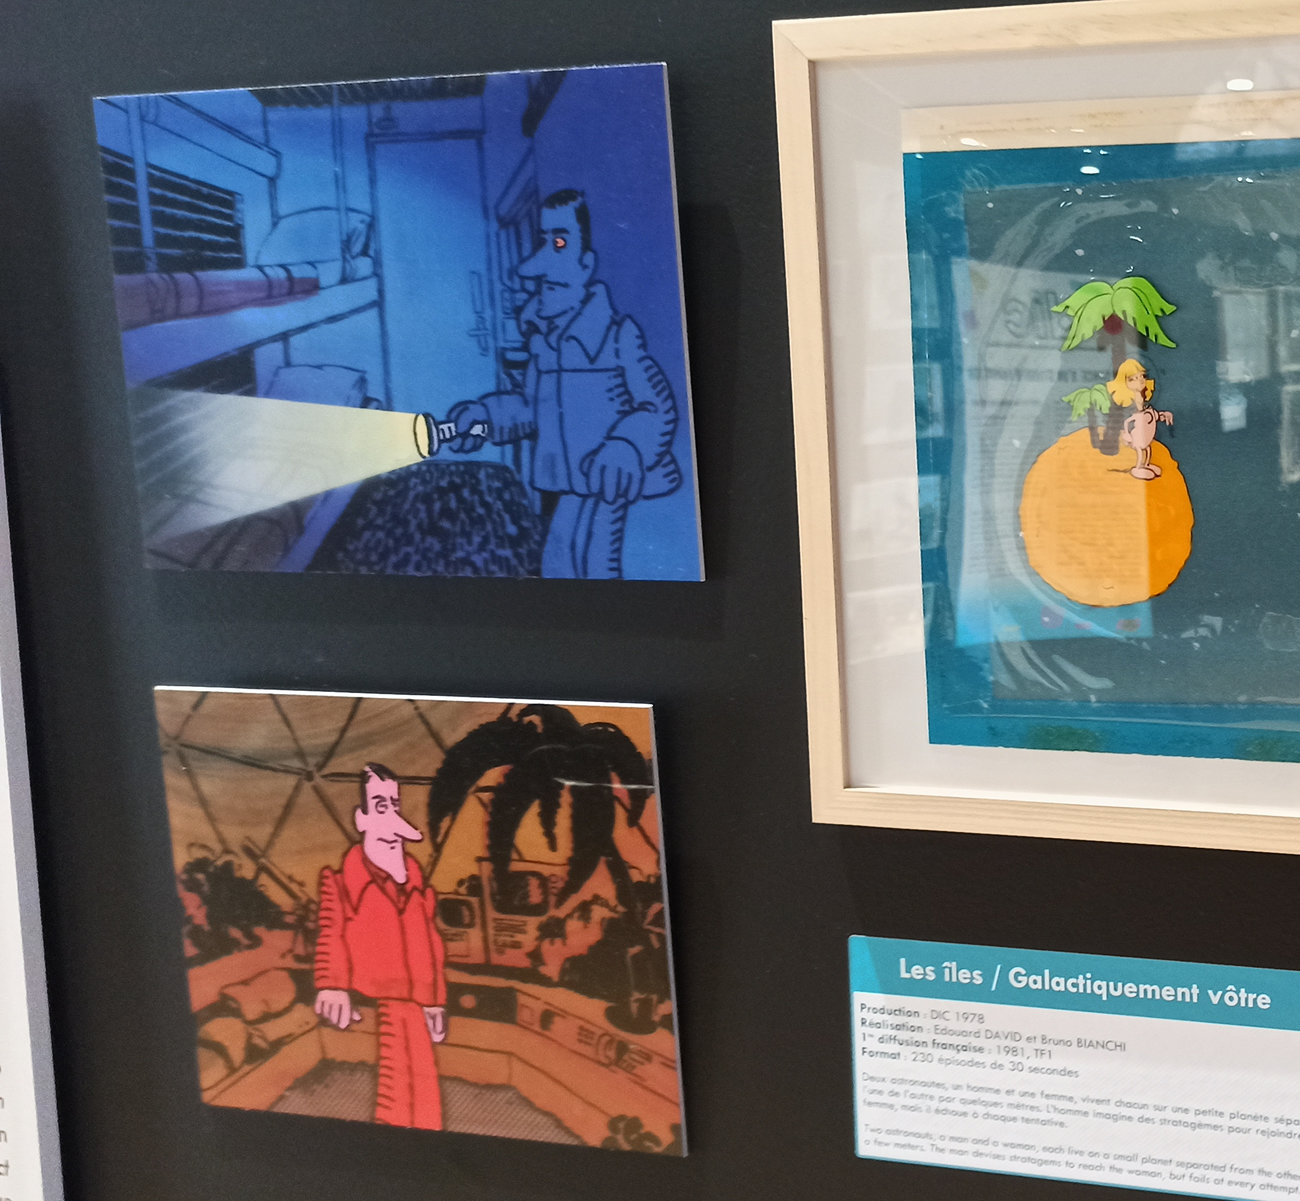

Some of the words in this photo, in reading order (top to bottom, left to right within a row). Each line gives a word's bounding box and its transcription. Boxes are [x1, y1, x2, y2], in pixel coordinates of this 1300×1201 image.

[899, 957, 936, 981] Les
[941, 961, 983, 984] îles
[991, 964, 1000, 991] /
[1008, 966, 1199, 1003] Galactiquement
[1207, 984, 1271, 1009] vôtre
[860, 1002, 920, 1017] Production
[930, 1009, 950, 1021] DIC
[955, 1011, 985, 1024] 1978
[860, 1017, 924, 1032] Réalisation
[933, 1024, 981, 1038] Edouard
[984, 1028, 1023, 1042] DAVID
[1025, 1035, 1038, 1043] et
[1040, 1034, 1073, 1047] Bruno
[1076, 1037, 1127, 1051] BIANCHI
[877, 1034, 928, 1047] diffusion
[930, 1038, 984, 1054] française
[1033, 1048, 1053, 1059] TF1
[861, 1047, 901, 1060] Format
[910, 1052, 934, 1063] 230
[937, 1056, 987, 1069] épisodes
[989, 1060, 1006, 1070] de
[1008, 1061, 1024, 1072] 30
[1027, 1066, 1079, 1078] secondes
[862, 1071, 886, 1083] Deux
[966, 1083, 1001, 1095] homme
[1018, 1091, 1036, 1099] une
[1080, 1095, 1111, 1105] vivent
[1114, 1099, 1149, 1110] chacun
[1152, 1104, 1168, 1112] sur
[1171, 1106, 1190, 1115] une
[1194, 1108, 1224, 1118] petite
[1229, 1111, 1269, 1123] planète
[938, 1095, 956, 1103] par
[959, 1097, 1004, 1108] quelques
[1093, 1111, 1134, 1123] imagine
[1137, 1114, 1155, 1125] des
[1159, 1118, 1224, 1132] stratagèmes
[1227, 1125, 1252, 1134] pour
[981, 1111, 1018, 1123] chaque
[930, 1143, 946, 1154] The
[971, 1149, 1006, 1161] devises
[1009, 1154, 1061, 1167] stratagems
[1065, 1160, 1075, 1169] to
[1078, 1163, 1105, 1171] reach
[1108, 1164, 1123, 1174] the
[1168, 1171, 1185, 1181] but
[1188, 1172, 1210, 1184] fails
[1227, 1180, 1255, 1191] every
[948, 1135, 969, 1143] man
[970, 1137, 990, 1146] and
[1041, 1145, 1065, 1154] each
[1113, 1153, 1138, 1162] small
[1141, 1155, 1172, 1165] planet
[1175, 1160, 1226, 1172] separated
[1229, 1163, 1254, 1175] from
[1257, 1167, 1273, 1177] the
